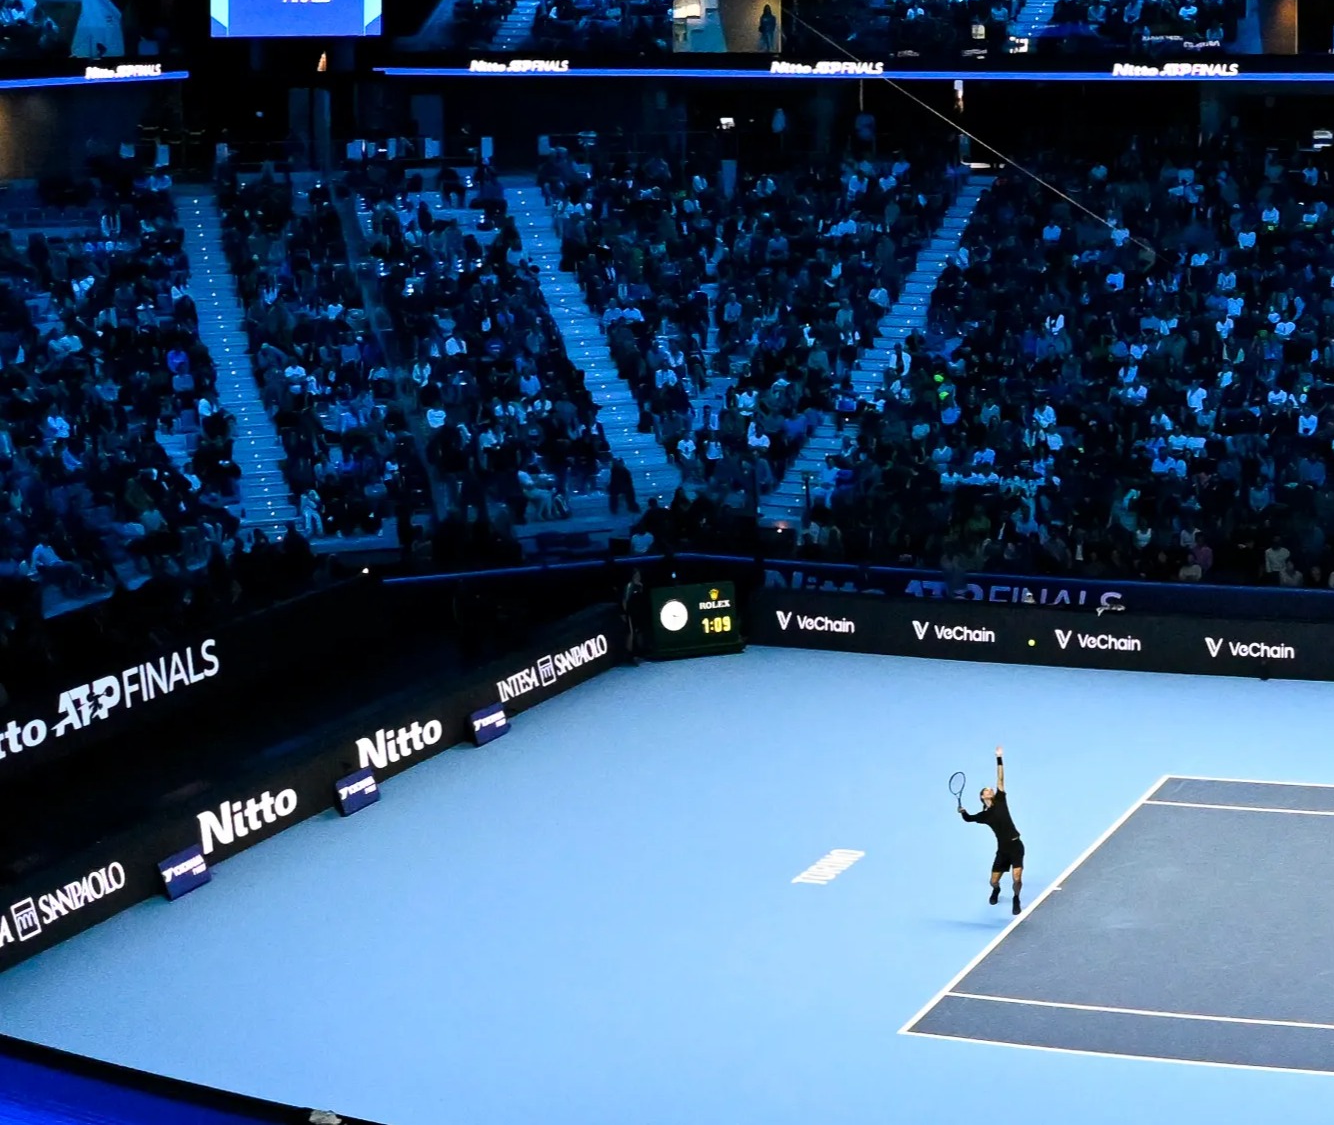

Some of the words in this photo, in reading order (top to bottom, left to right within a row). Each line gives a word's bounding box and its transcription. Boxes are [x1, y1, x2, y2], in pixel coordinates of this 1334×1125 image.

[1190, 63, 1239, 77] FINALS
[699, 599, 731, 611] ROLEX
[702, 615, 731, 633] 1:09
[796, 614, 855, 634] VeChain
[934, 624, 996, 643] VeChain
[1077, 633, 1142, 651] VeChain
[1228, 641, 1295, 659] VeChain
[496, 666, 540, 704] INTESA
[553, 634, 608, 676] SANPAOLO
[51, 675, 121, 738] ATP
[122, 638, 219, 709] FINALS
[355, 719, 443, 769] Nitto
[196, 787, 298, 855] Nitto
[38, 861, 125, 925] SANPAOLO
